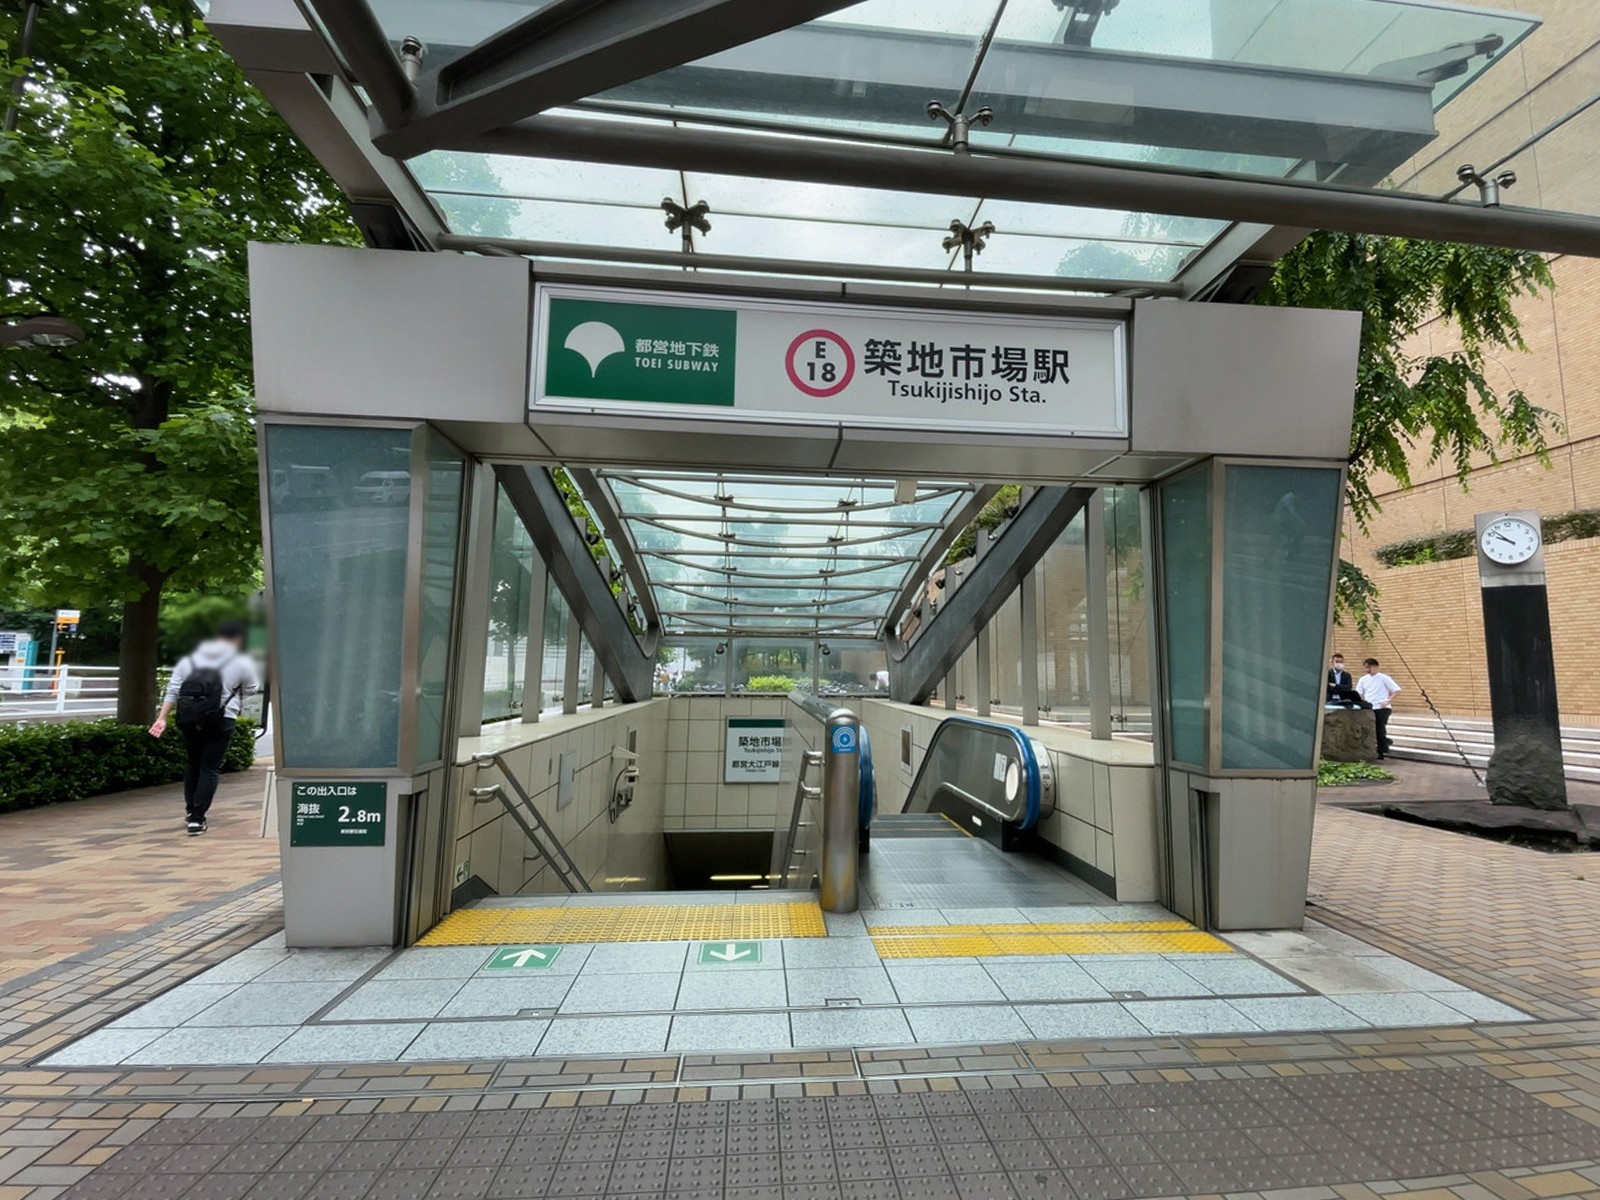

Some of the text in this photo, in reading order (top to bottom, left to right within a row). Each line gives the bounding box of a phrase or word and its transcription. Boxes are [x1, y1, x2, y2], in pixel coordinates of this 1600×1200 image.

[634, 337, 720, 358] 都営地下鉄
[814, 341, 827, 359] E
[634, 356, 719, 373] TOEI SUBWAY
[863, 338, 1071, 385] 築地市場駅
[806, 361, 837, 383] 18
[887, 379, 1047, 406] Tsukijishijo Sta.
[297, 786, 357, 796] この出入口は
[337, 805, 381, 823] 2.8m
